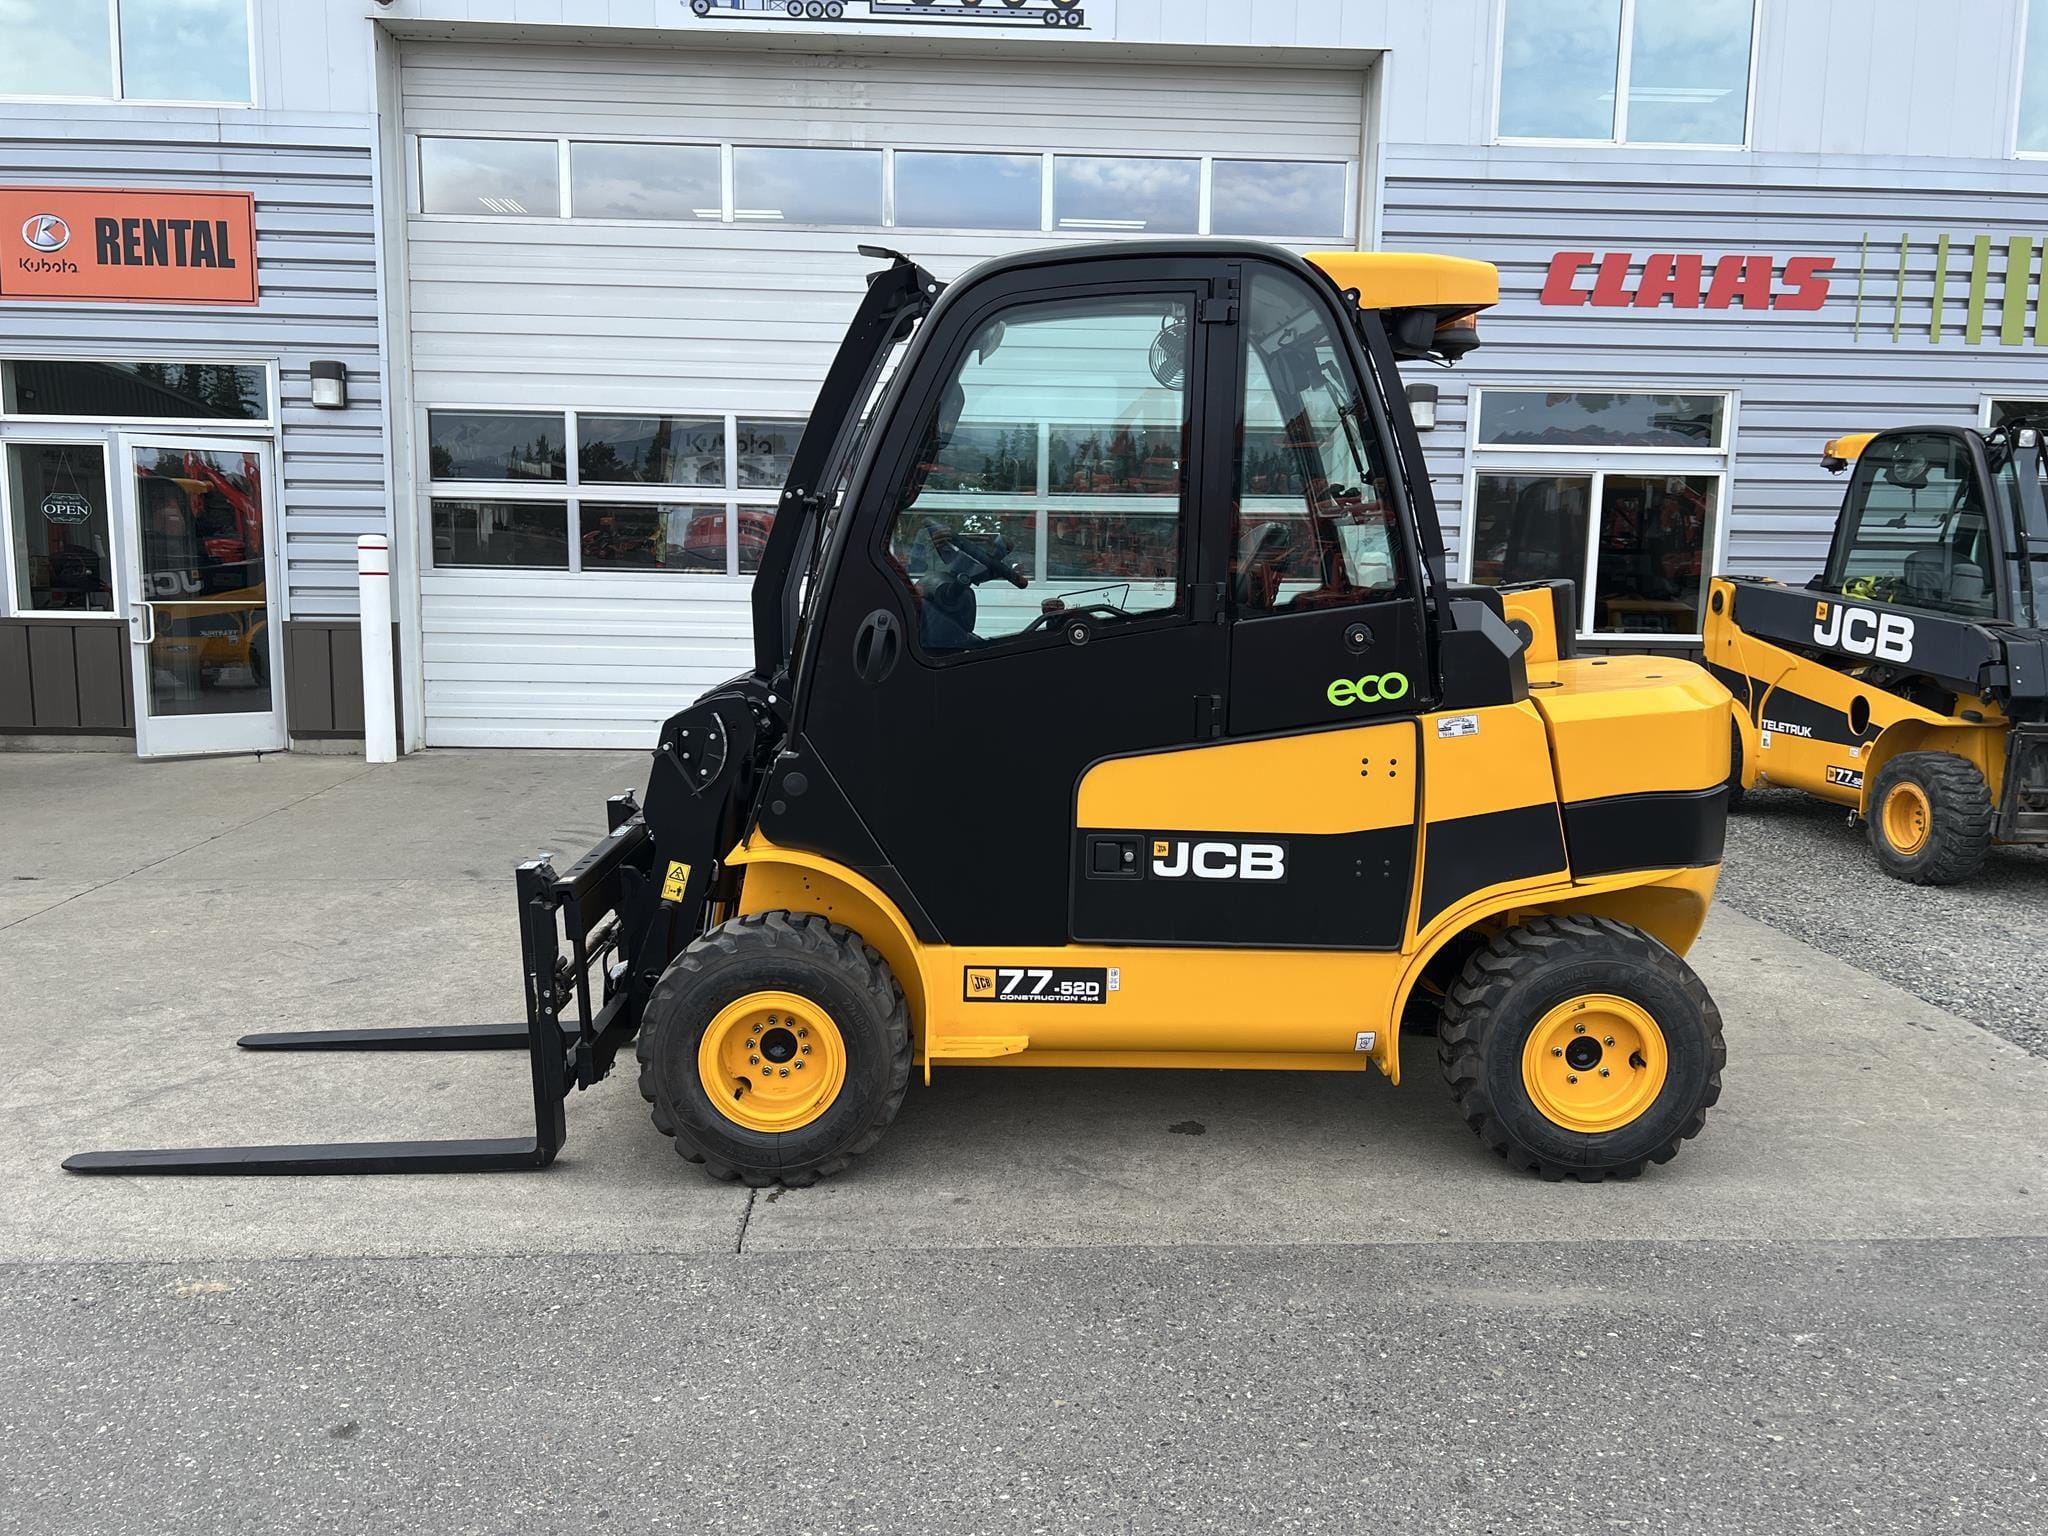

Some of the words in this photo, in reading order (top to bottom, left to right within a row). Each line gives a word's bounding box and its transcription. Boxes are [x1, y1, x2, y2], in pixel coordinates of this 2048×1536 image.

[95, 218, 236, 268] RENTAL
[19, 257, 80, 273] Kubota
[1540, 252, 1836, 310] CLAAS
[43, 504, 89, 515] OPEN
[1813, 604, 1915, 663] JCB
[1327, 672, 1408, 706] eco
[1762, 719, 1812, 738] TELETRUK
[1153, 841, 1285, 880] JCB
[974, 976, 992, 990] JCB
